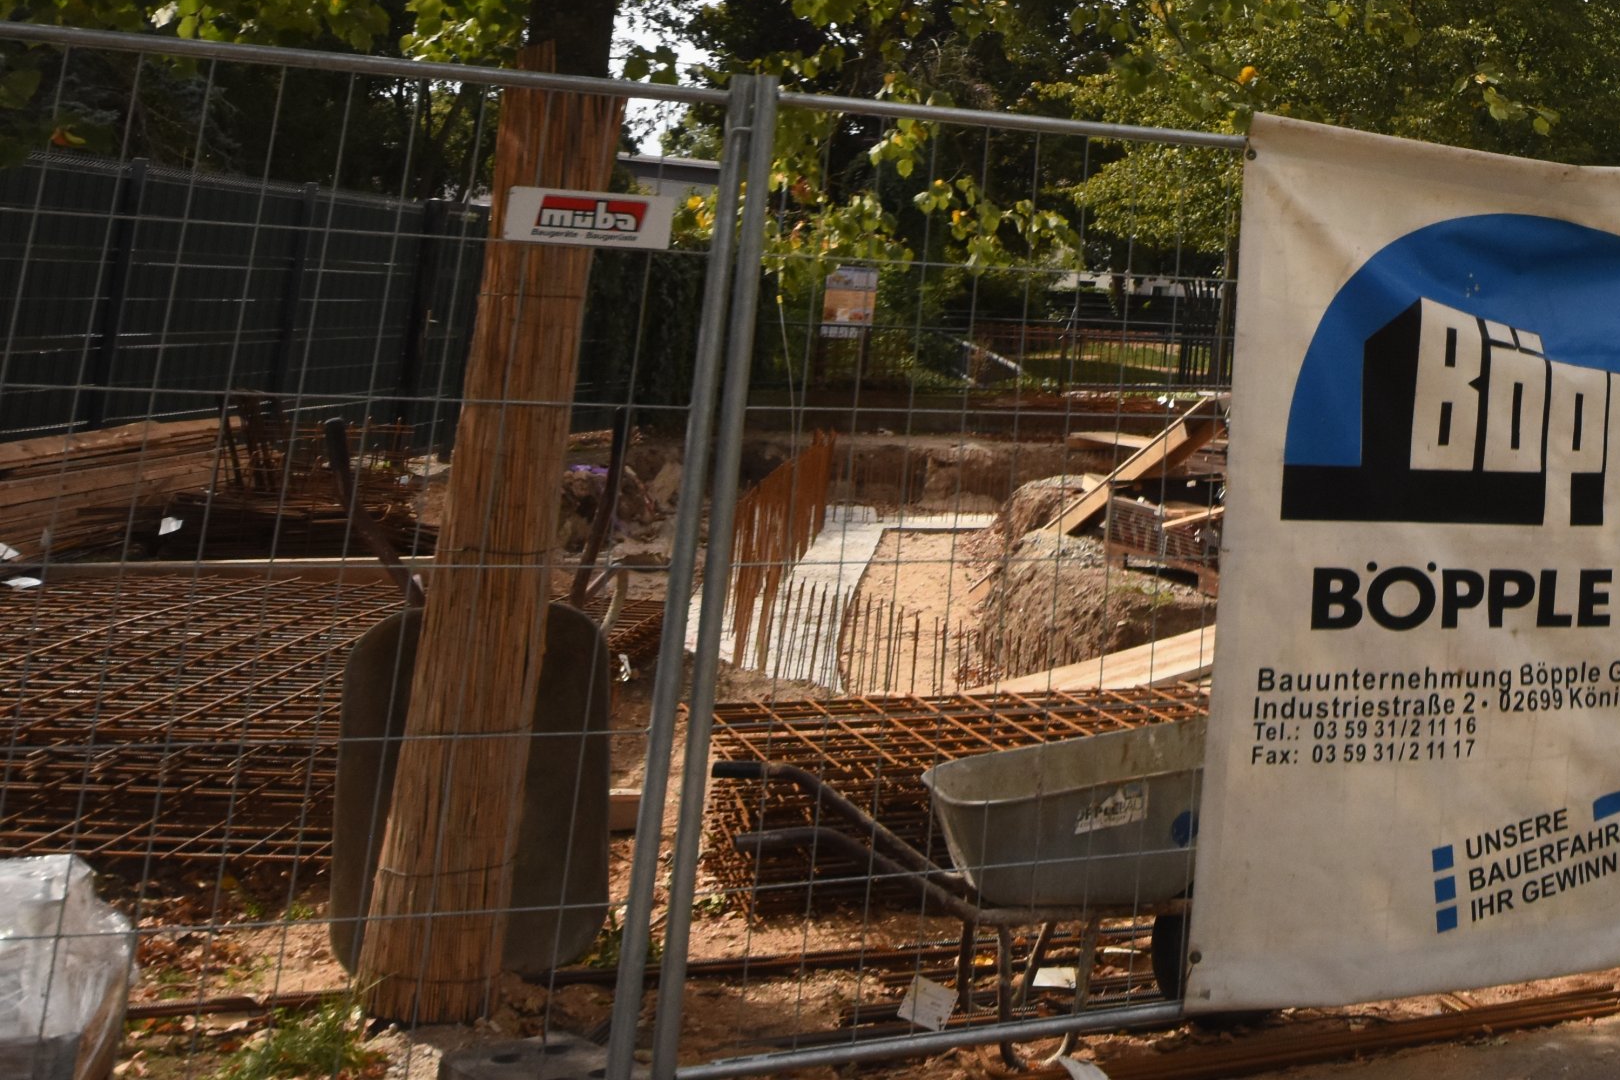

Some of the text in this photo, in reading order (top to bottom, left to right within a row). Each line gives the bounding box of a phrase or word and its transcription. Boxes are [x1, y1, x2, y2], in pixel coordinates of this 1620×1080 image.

[539, 200, 638, 231] müba
[1257, 666, 1512, 692] Bauunternehmung
[1520, 662, 1601, 689] Böpple
[1253, 693, 1456, 720] Industriestraße
[1499, 688, 1563, 713] 02699
[1253, 722, 1300, 741] Tel.:
[1313, 721, 1338, 740] 03
[1345, 720, 1367, 739] 59
[1428, 718, 1447, 736] 11
[1454, 716, 1477, 735] 16
[1251, 746, 1299, 765] Fax:
[1312, 745, 1336, 764] 03
[1343, 744, 1367, 763] 59
[1426, 741, 1446, 760] 11
[1453, 739, 1476, 759] 17
[1465, 808, 1569, 860] UNSERE
[1471, 852, 1618, 922] IHR GEWINN
